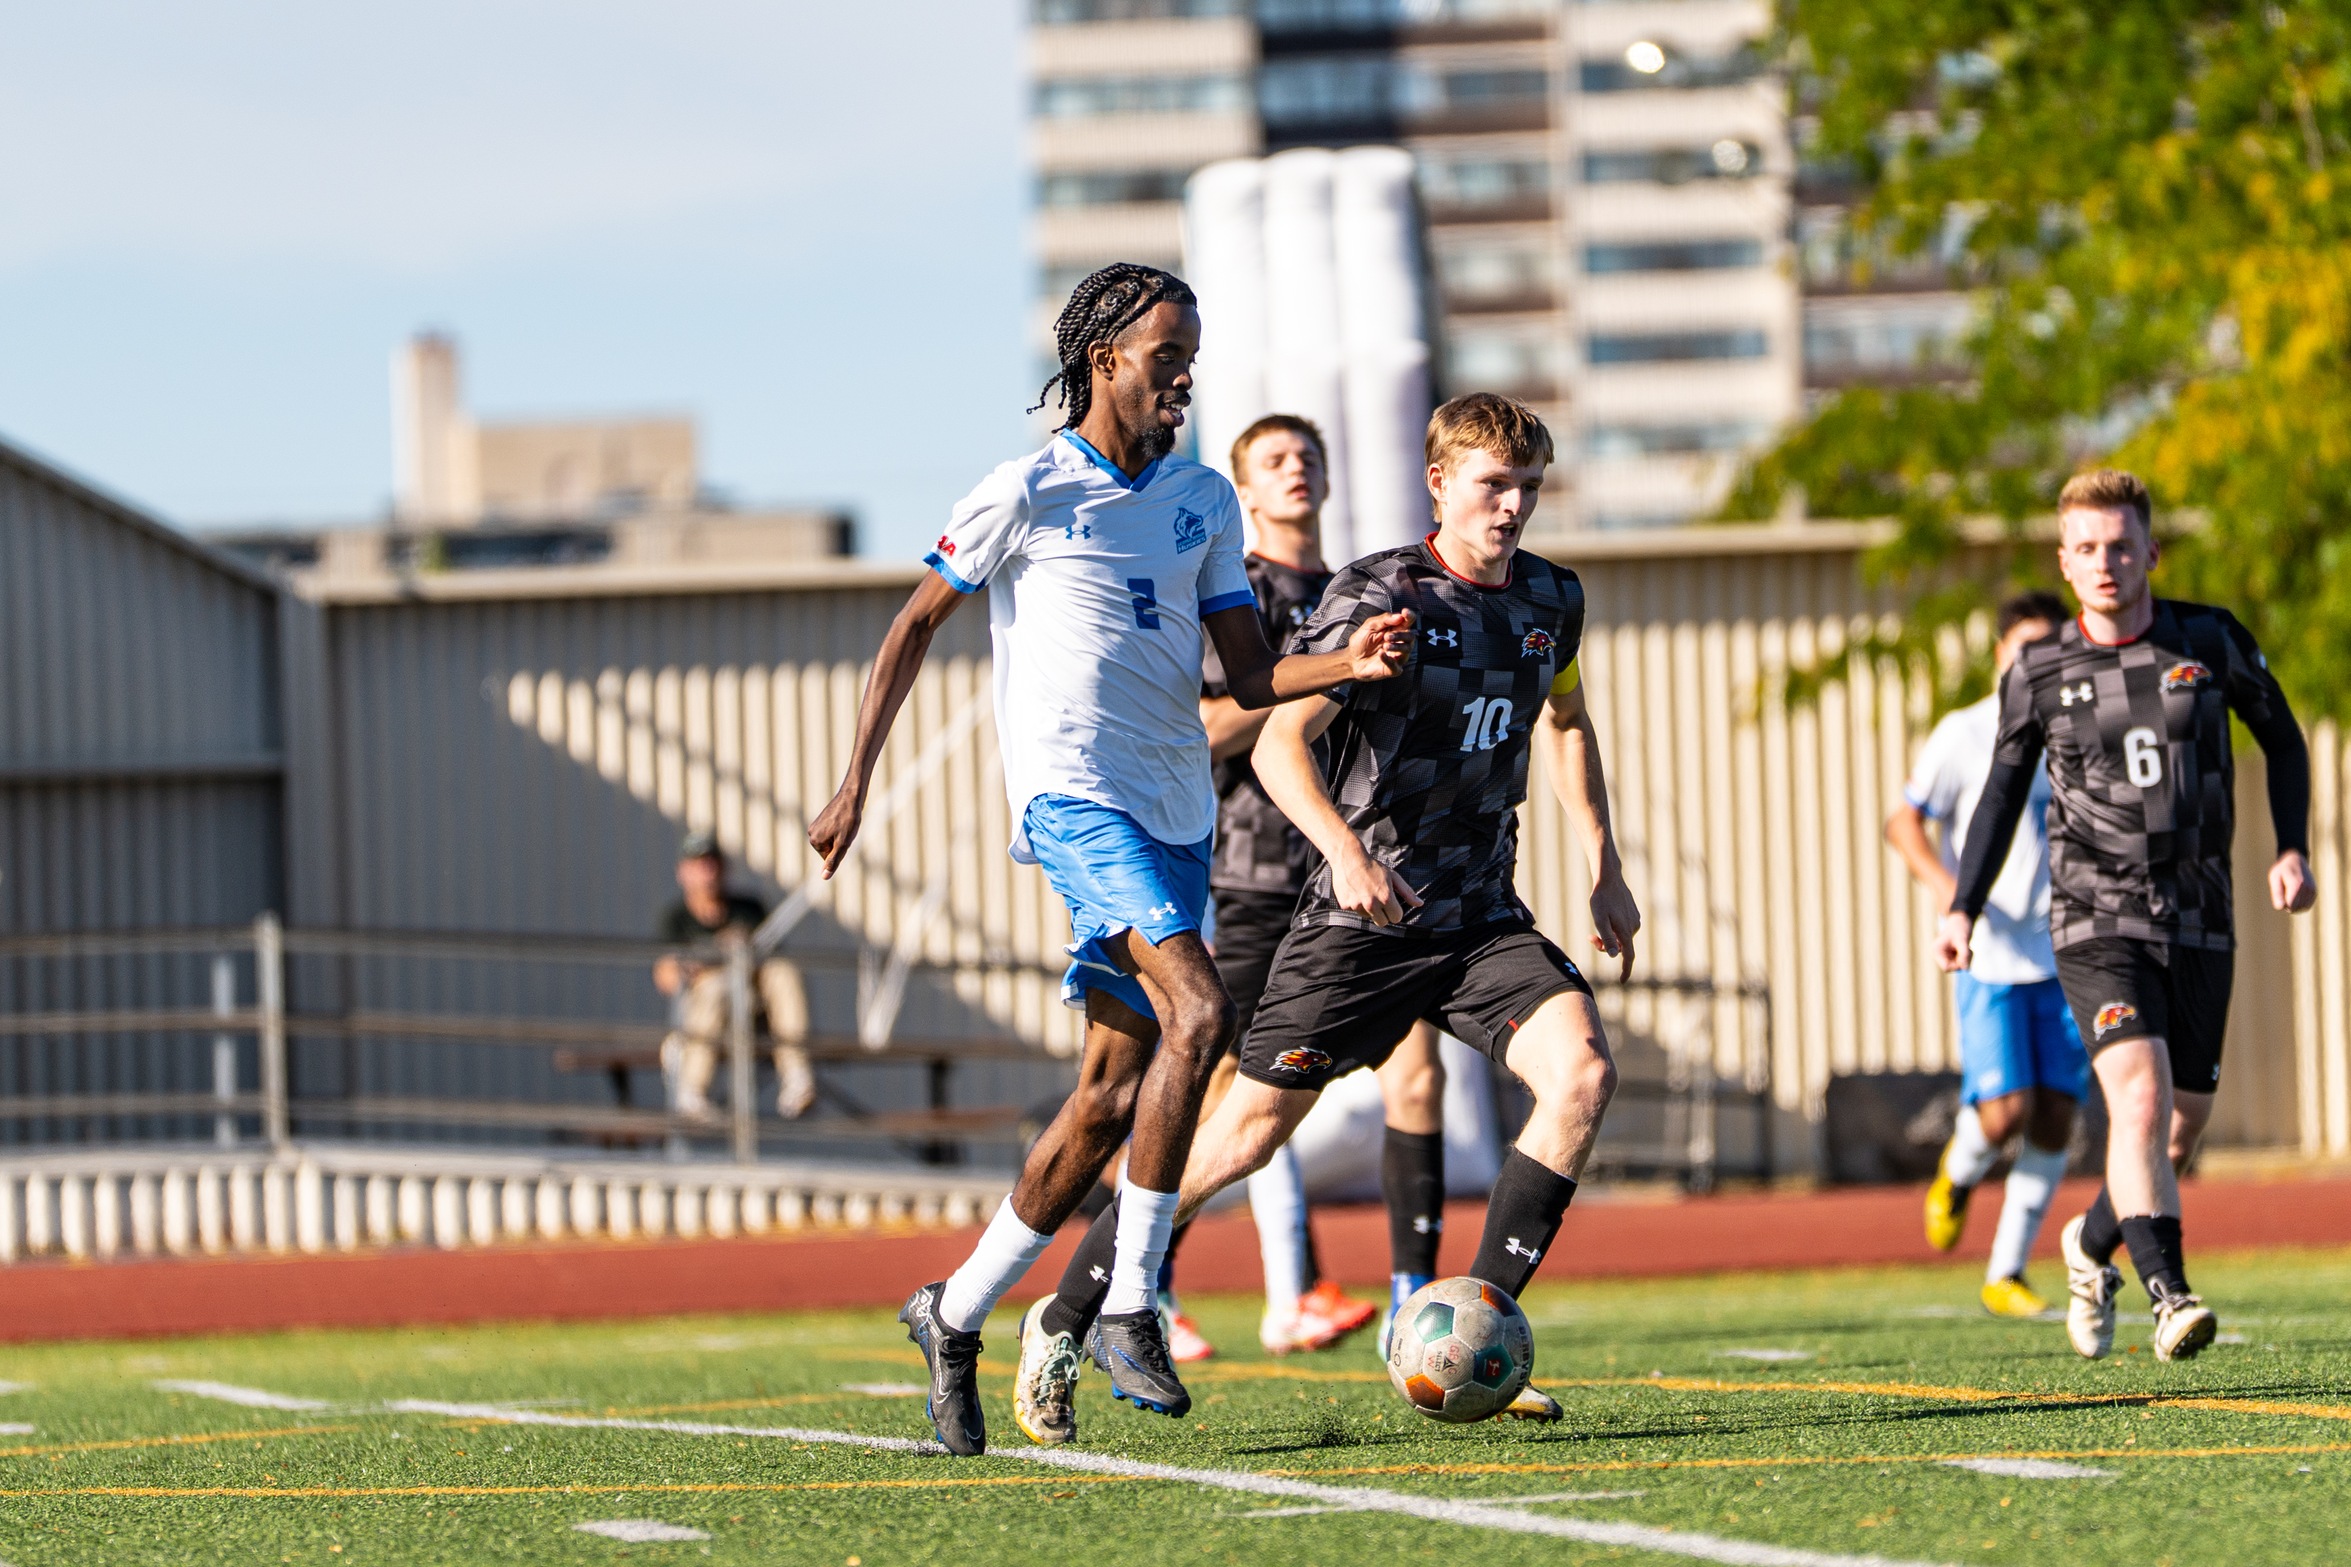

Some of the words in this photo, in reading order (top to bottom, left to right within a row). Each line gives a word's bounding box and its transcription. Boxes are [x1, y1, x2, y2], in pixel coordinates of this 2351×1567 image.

[1127, 578, 1161, 630] 2
[1460, 697, 1513, 752] 10
[2124, 727, 2162, 788] 6
